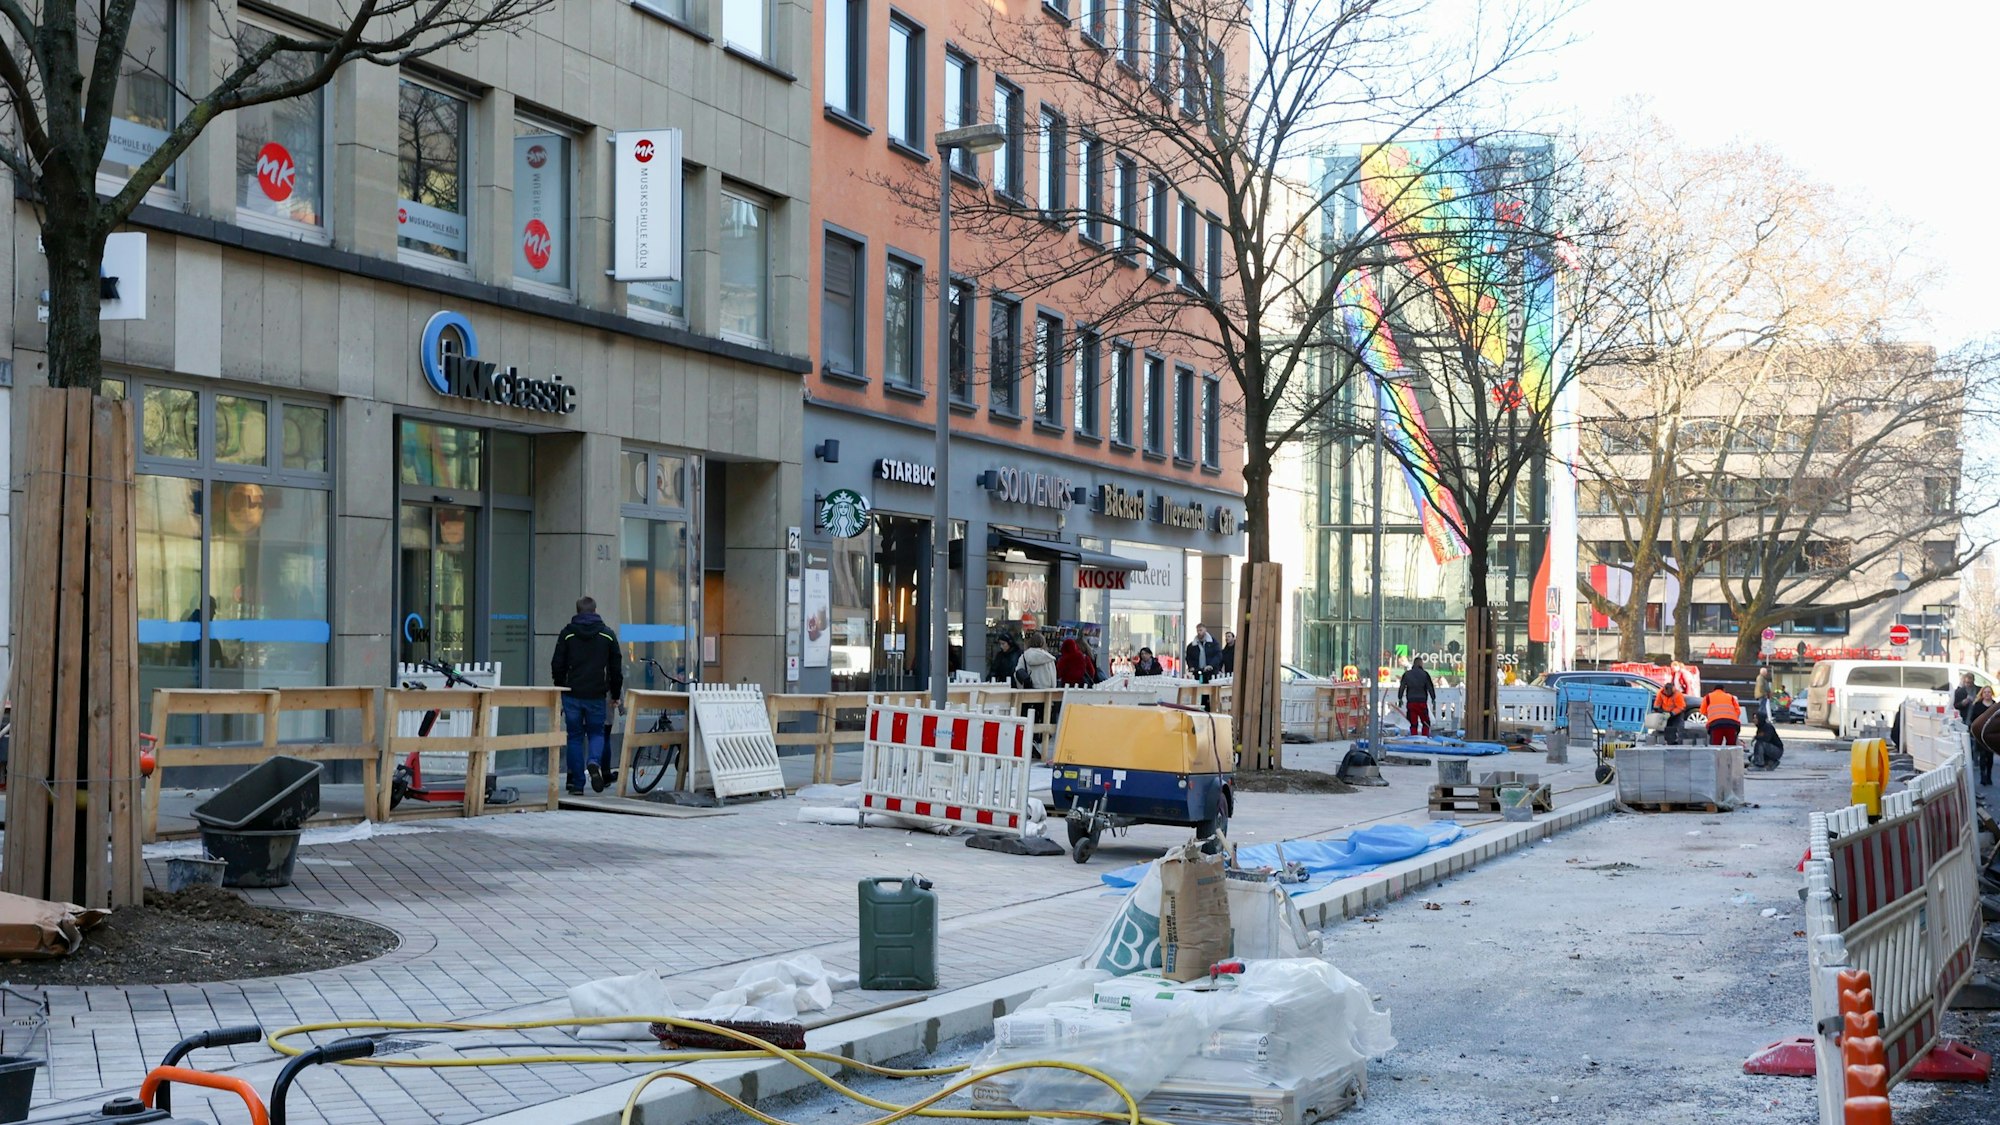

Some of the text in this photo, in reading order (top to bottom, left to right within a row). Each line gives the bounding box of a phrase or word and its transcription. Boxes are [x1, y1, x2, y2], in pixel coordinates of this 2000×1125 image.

[634, 143, 655, 157] MK
[257, 154, 296, 188] MK
[639, 167, 648, 269] MUSIKSCHULE KÖLN
[881, 458, 936, 487] STARBUC
[1000, 466, 1072, 511] SOUVENIRS
[1104, 483, 1146, 521] Bäckerei
[790, 532, 800, 549] 21
[1078, 570, 1126, 590] KIOSK
